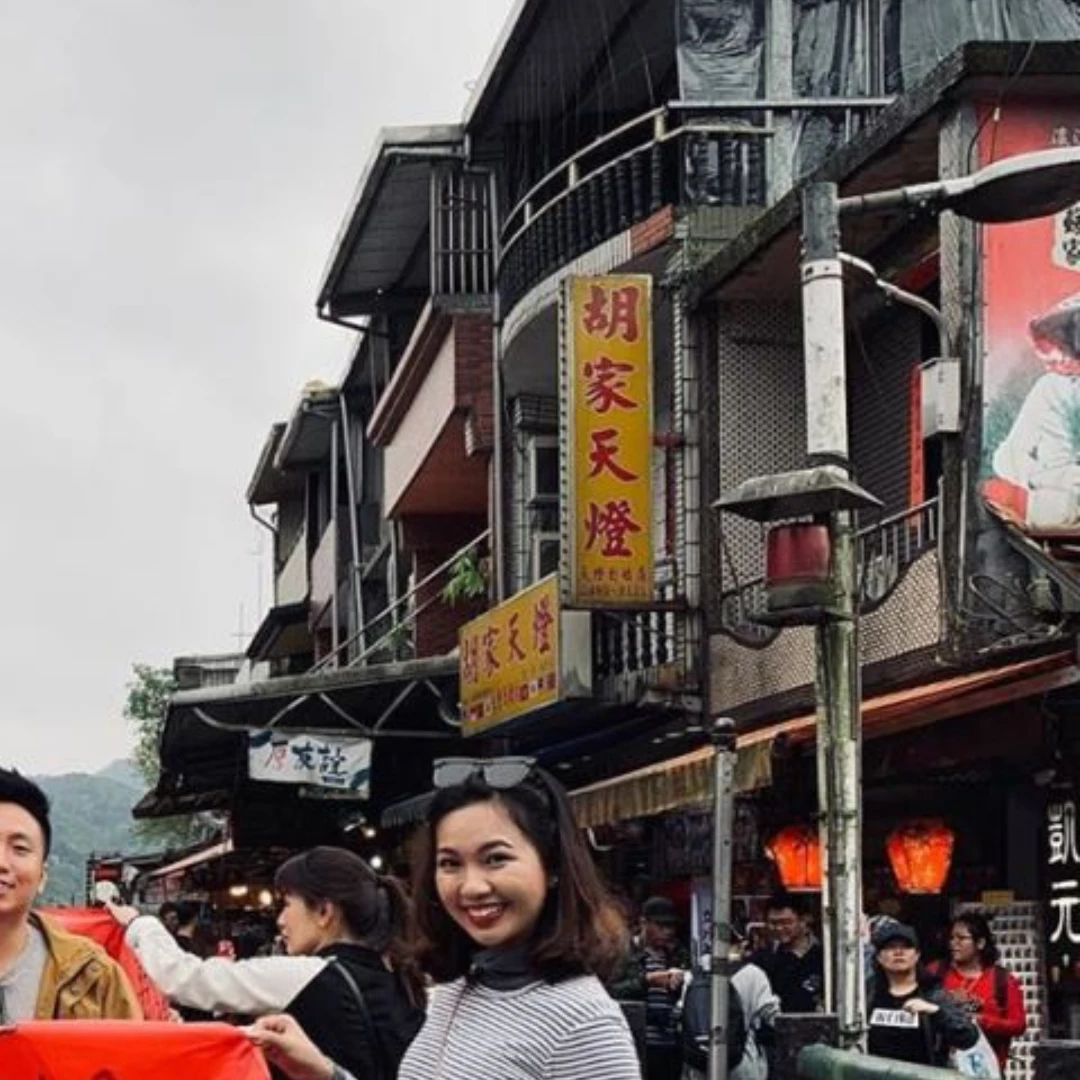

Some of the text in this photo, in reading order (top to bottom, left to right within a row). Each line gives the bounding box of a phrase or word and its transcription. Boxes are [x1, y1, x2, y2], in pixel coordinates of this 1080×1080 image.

[583, 284, 642, 557] 胡家天燈
[462, 594, 554, 685] 胡家天燈
